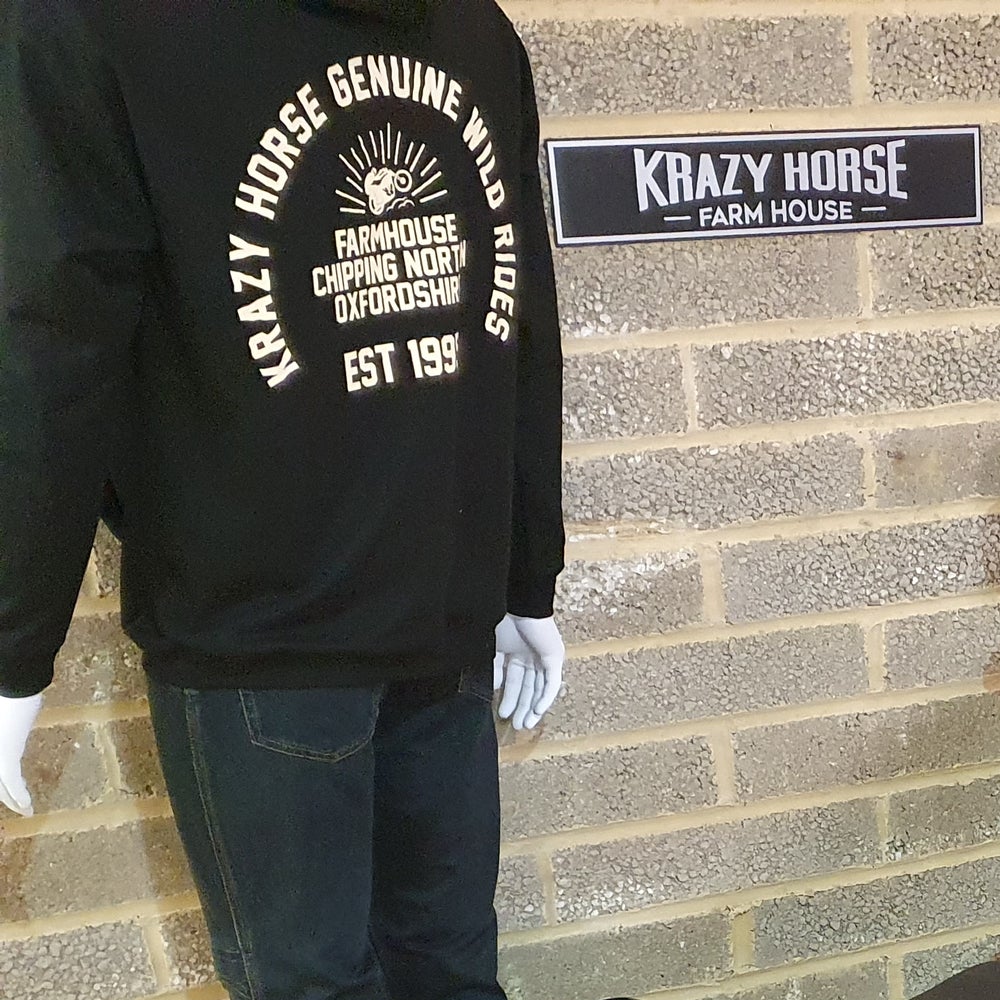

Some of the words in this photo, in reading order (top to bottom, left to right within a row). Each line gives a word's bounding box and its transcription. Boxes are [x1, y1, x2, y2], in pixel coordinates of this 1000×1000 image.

[326, 55, 462, 122] GENUINE
[234, 83, 329, 220] HORSE
[462, 105, 506, 211] WILD
[632, 146, 773, 213] KRAZY
[783, 139, 908, 200] HORSE
[334, 213, 459, 260] FARMHOUSE
[698, 201, 764, 227] FARM
[771, 199, 853, 223] HOUSE
[312, 252, 398, 297] CHIPPING
[334, 275, 460, 324] OXFORDSHIR
[484, 223, 516, 342] RIDES
[229, 233, 300, 388] KRAZY
[343, 342, 395, 392] EST
[406, 332, 459, 379] 199
